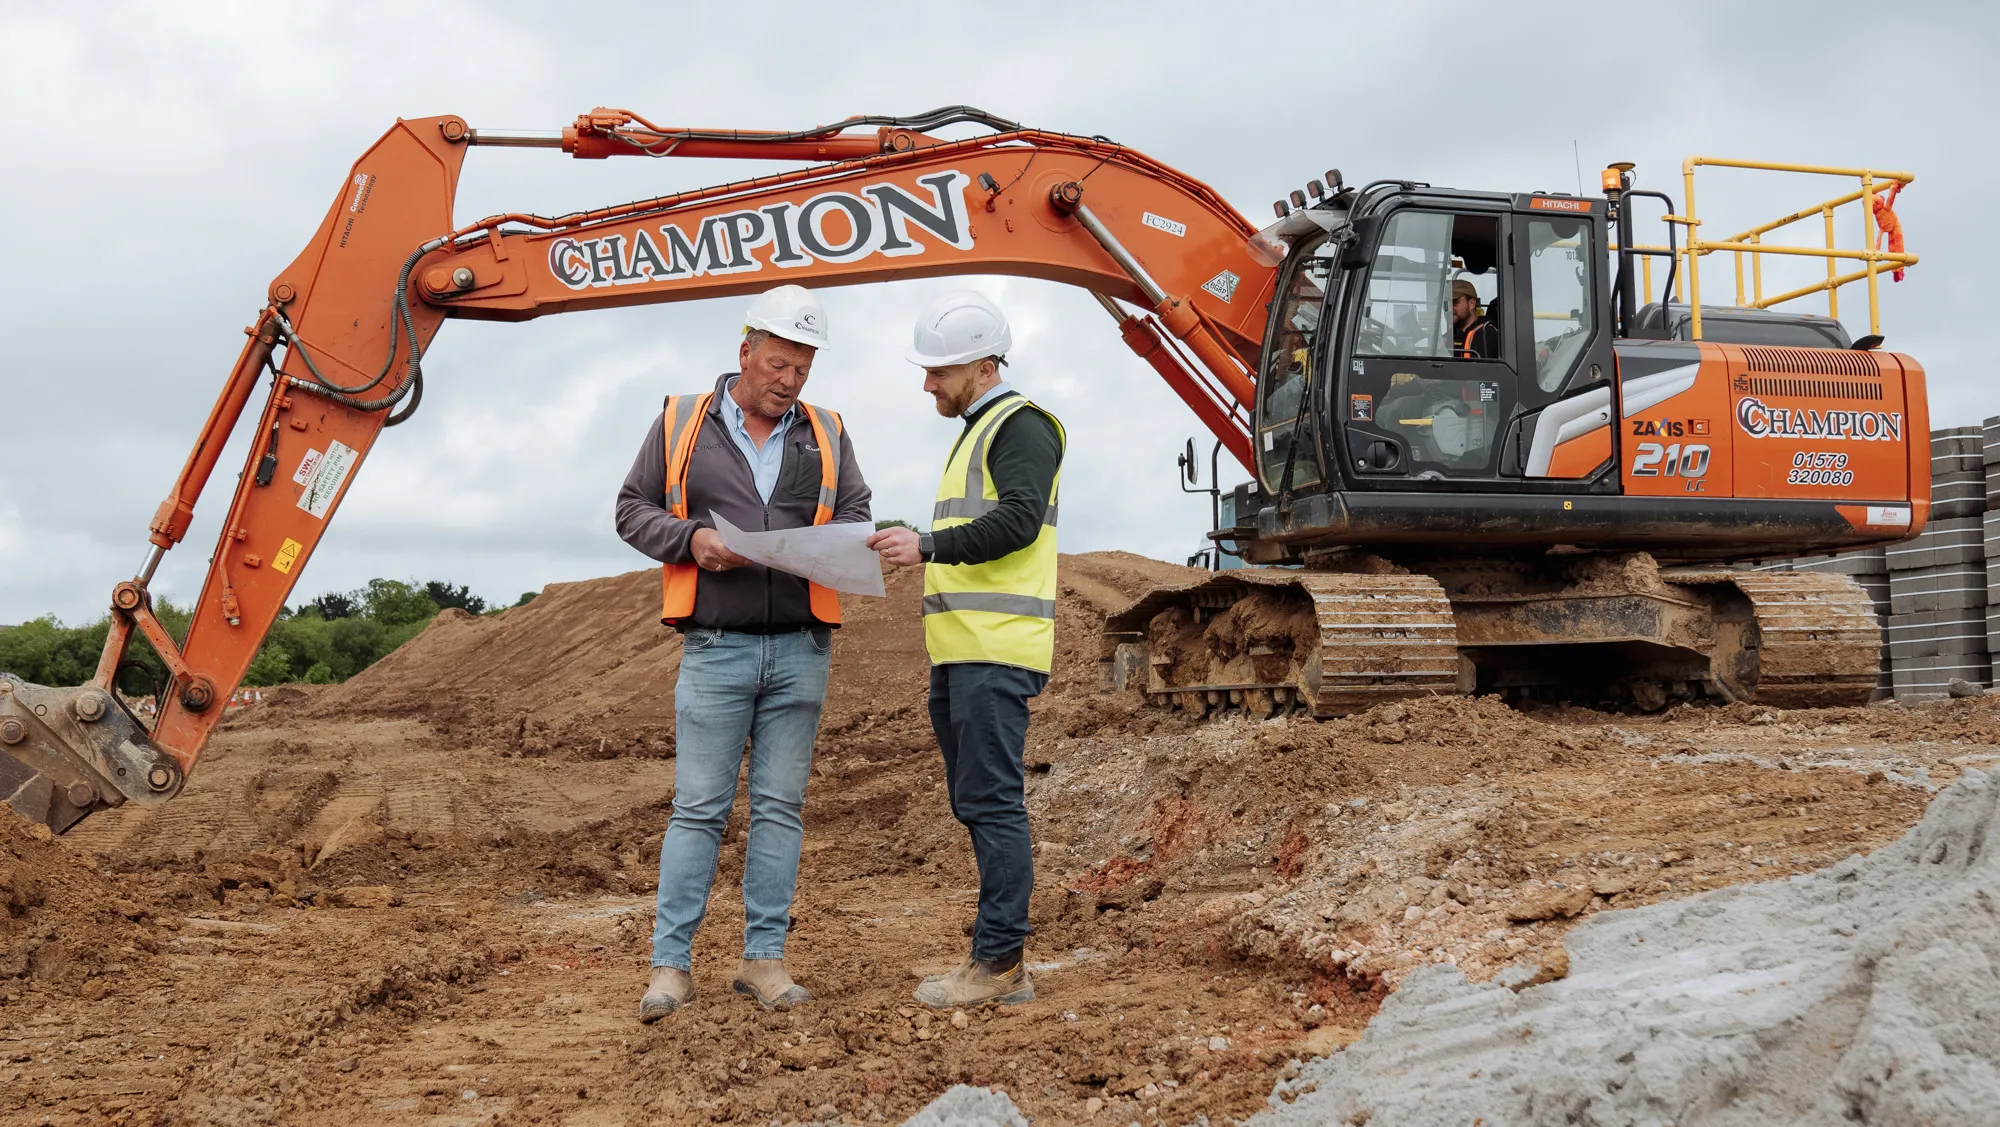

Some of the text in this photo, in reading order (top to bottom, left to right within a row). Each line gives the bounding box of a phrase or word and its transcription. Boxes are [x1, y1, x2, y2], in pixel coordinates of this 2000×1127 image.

[357, 174, 377, 214] Technology
[1542, 199, 1580, 210] HITACHI
[339, 217, 355, 248] HITACHI
[1145, 214, 1184, 235] FC2924
[1632, 418, 1684, 437] ZAXIS
[1737, 397, 1900, 440] CHAMPION
[298, 455, 314, 476] SWL
[1632, 443, 1711, 477] 210
[1793, 452, 1848, 469] 01579
[311, 453, 343, 504] NO SAFETY PIN
[322, 464, 345, 500] REQUIRED
[1685, 480, 1707, 492] LC
[1787, 469, 1853, 486] 320080
